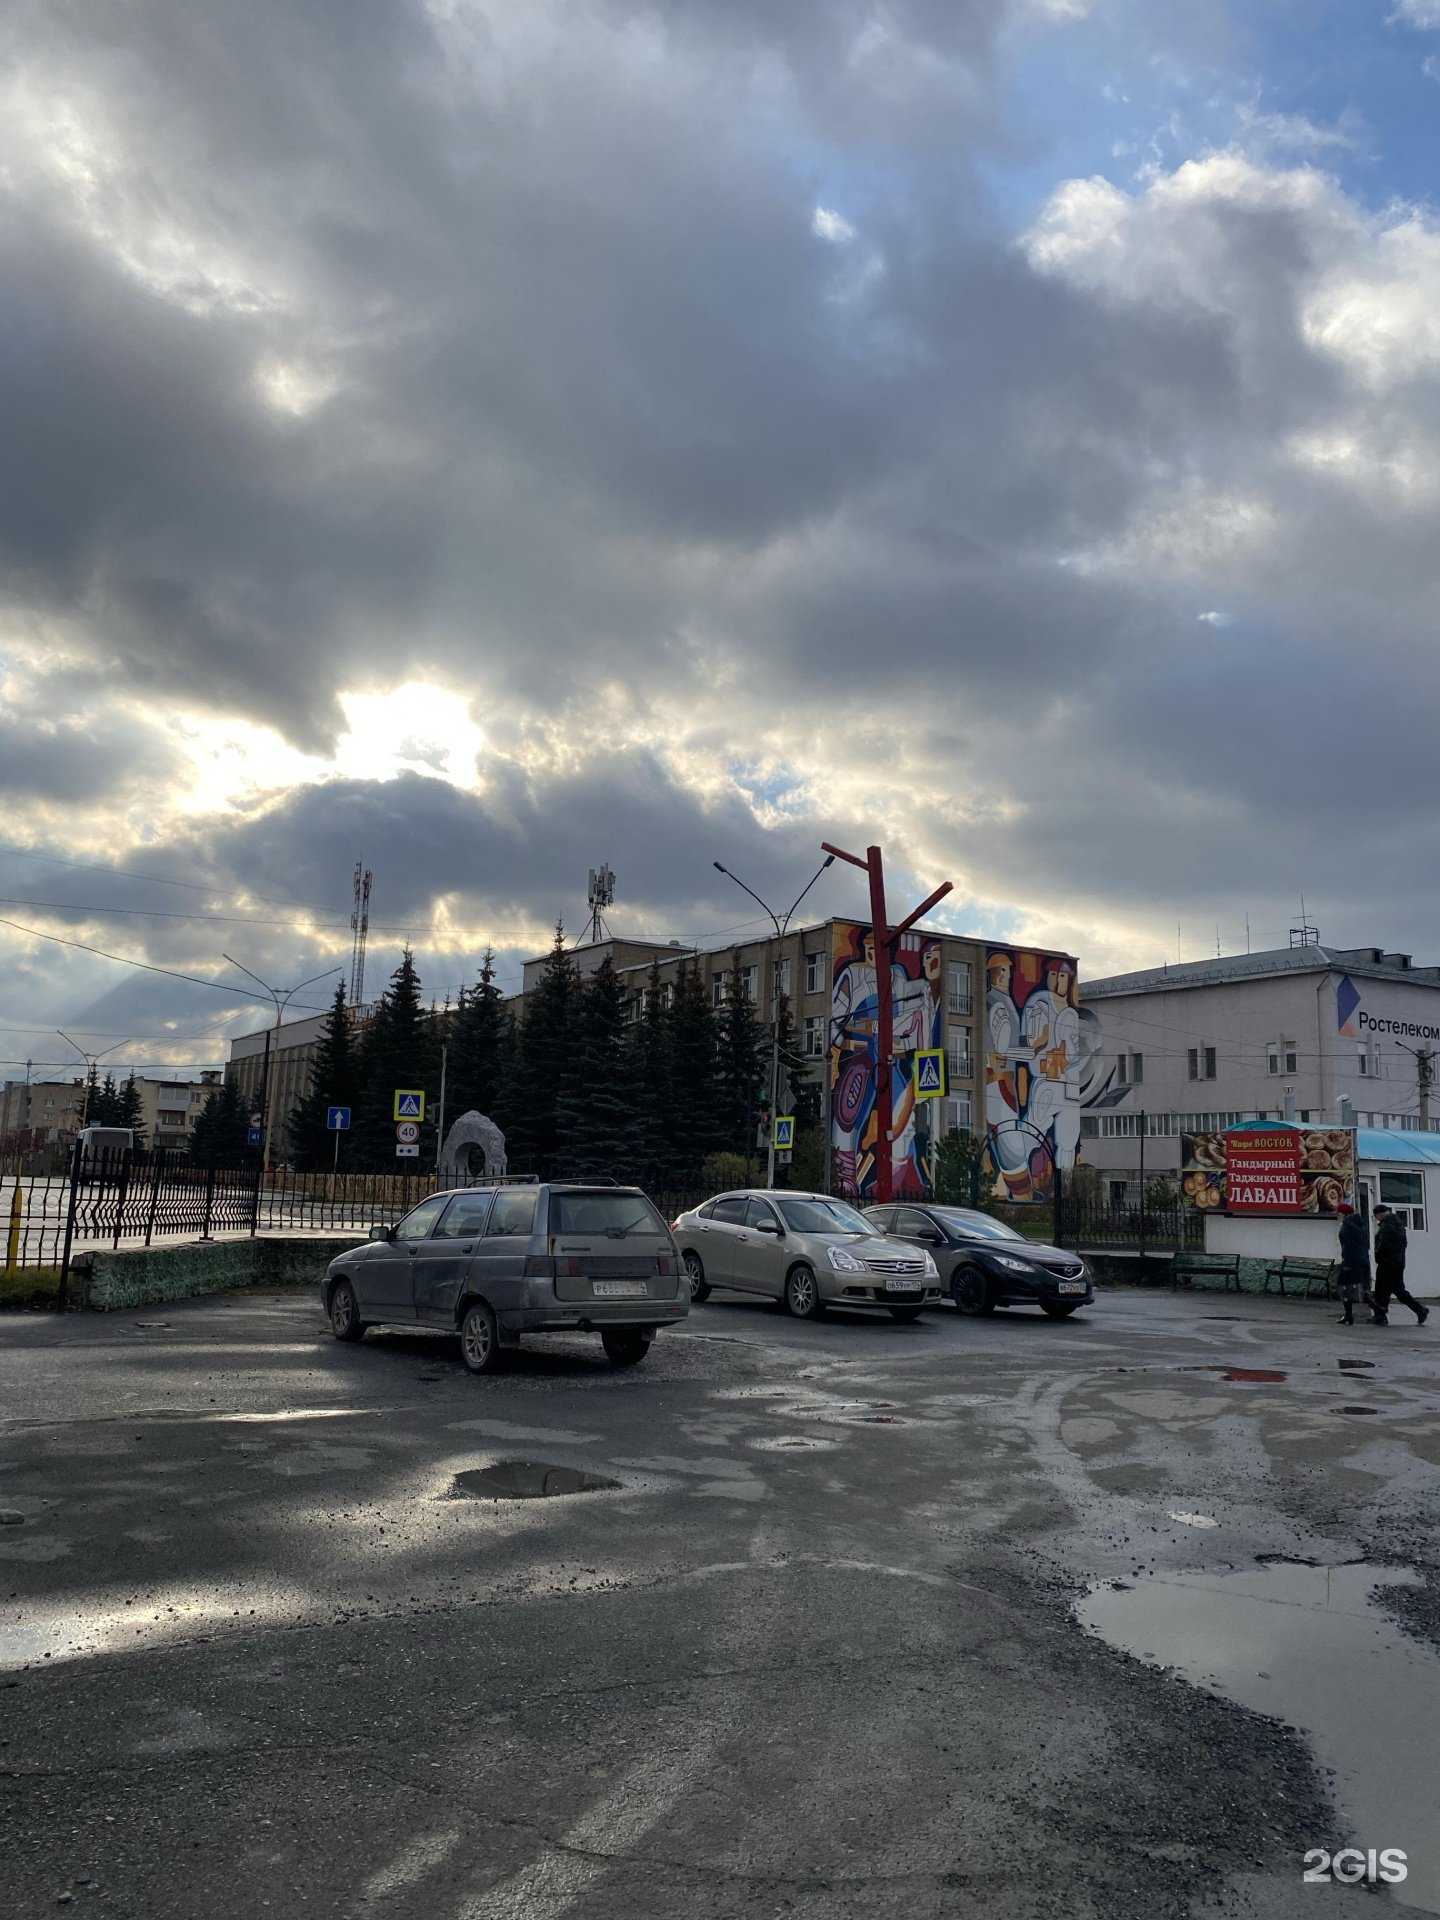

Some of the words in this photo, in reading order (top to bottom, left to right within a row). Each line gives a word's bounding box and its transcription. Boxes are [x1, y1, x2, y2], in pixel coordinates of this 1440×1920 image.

[1359, 1011, 1440, 1041] Ростелеком
[401, 1127, 415, 1137] 40
[1255, 1137, 1293, 1148] ВОСТОК
[1230, 1158, 1296, 1171] Тандырный
[1229, 1172, 1297, 1183] Таджикский
[1229, 1187, 1298, 1204] ЛАВАШ
